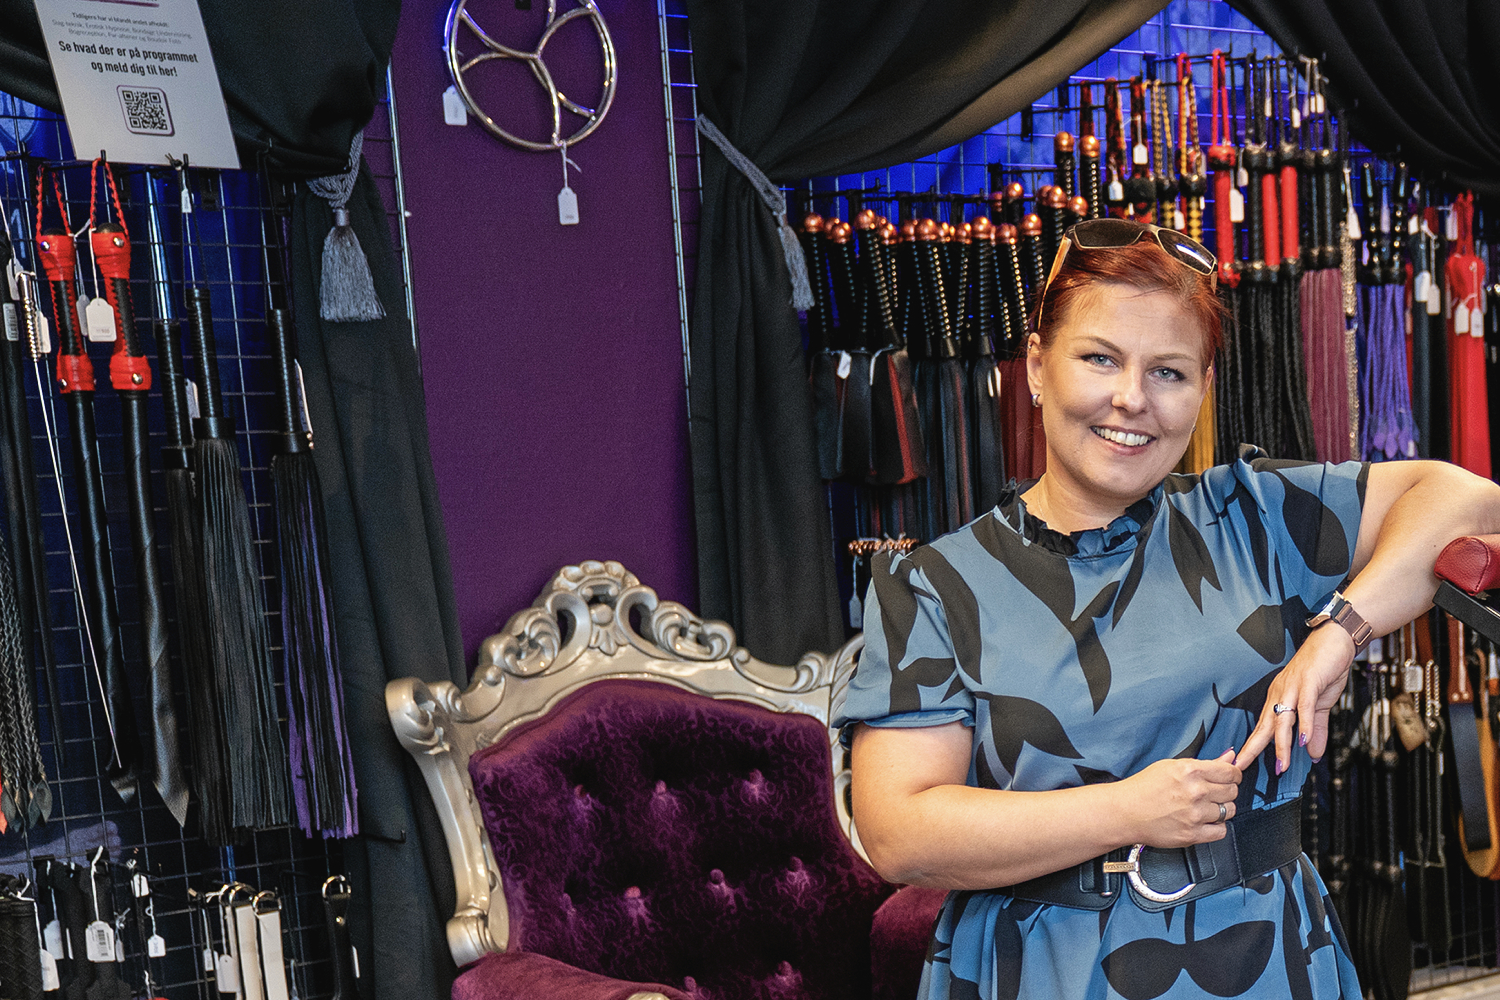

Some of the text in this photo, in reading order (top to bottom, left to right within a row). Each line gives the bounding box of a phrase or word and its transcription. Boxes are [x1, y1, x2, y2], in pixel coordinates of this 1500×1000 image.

[58, 40, 198, 63] Se hvad der er på programmet
[91, 61, 178, 76] og meld dig til her!
